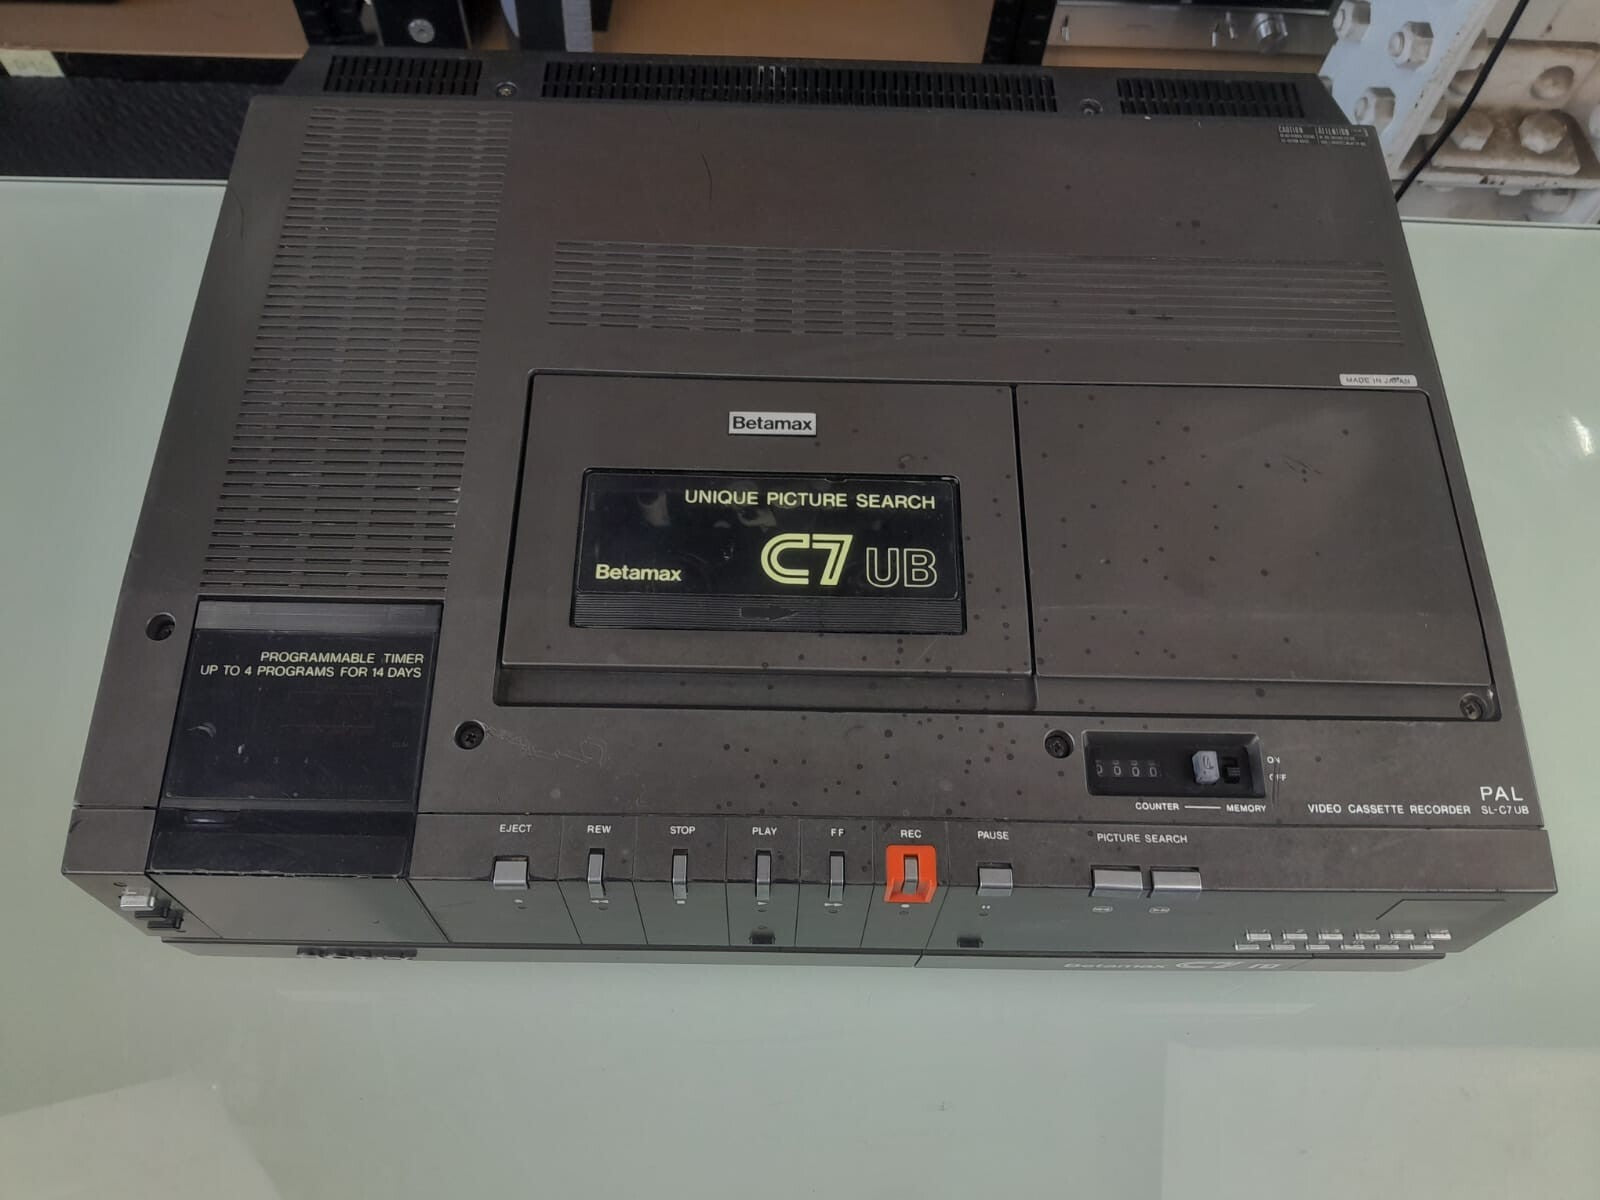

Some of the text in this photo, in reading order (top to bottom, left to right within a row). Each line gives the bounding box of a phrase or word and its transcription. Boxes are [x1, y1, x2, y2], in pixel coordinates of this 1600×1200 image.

[1345, 376, 1370, 384] MADE
[1373, 377, 1382, 385] IN
[732, 415, 813, 431] Betamax
[684, 489, 936, 510] UNIQUE PICTURE SEARCH
[760, 532, 938, 588] C7 UB
[595, 563, 682, 582] Betamax
[260, 651, 425, 664] PROGRAMMABLE TIMER
[200, 664, 422, 678] UP TO 4 PROGRAMS FOR 14 DAYS
[1480, 785, 1524, 802] PAL
[1135, 802, 1180, 811] COUNTER
[1226, 803, 1267, 813] MEMORY
[1307, 803, 1471, 815] VIDEO CASSETTE RECORDER
[499, 823, 532, 834] EJECT
[587, 824, 612, 834] REW
[669, 825, 696, 835] STOP
[752, 826, 777, 836] PLAY
[900, 828, 922, 839] REC
[977, 830, 1010, 841] PAUSE
[1096, 832, 1189, 844] PICTURE SEARCH
